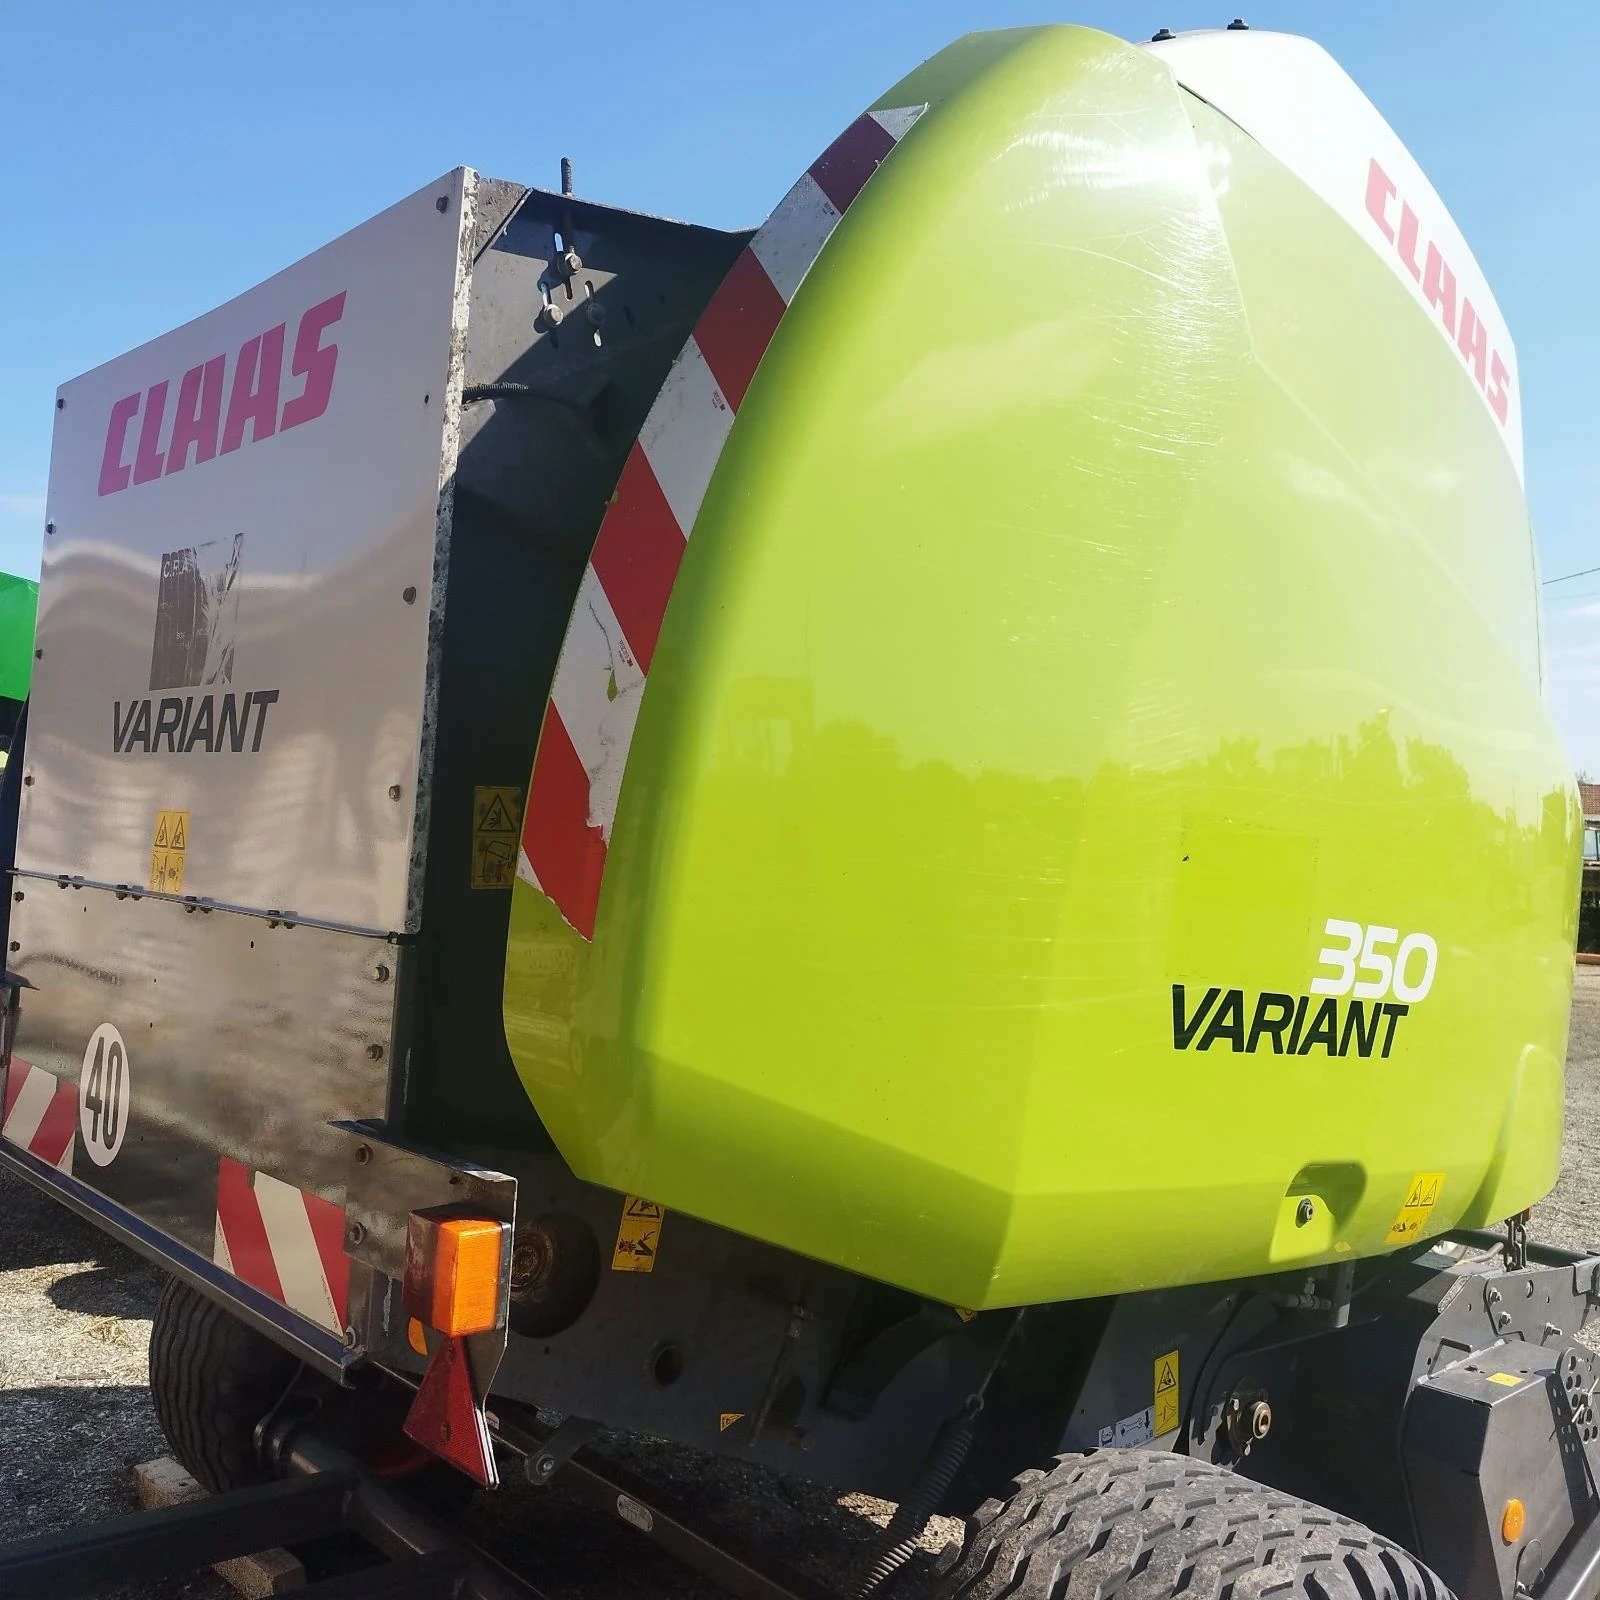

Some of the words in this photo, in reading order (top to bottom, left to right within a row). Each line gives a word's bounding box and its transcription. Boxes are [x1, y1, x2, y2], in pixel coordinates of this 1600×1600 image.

[1365, 157, 1510, 428] CLAAS
[97, 290, 347, 497] CLAAS
[113, 690, 280, 753] VARIANT
[1310, 918, 1438, 1003] 350
[1172, 984, 1409, 1058] VARIANT
[86, 1036, 122, 1150] 40
